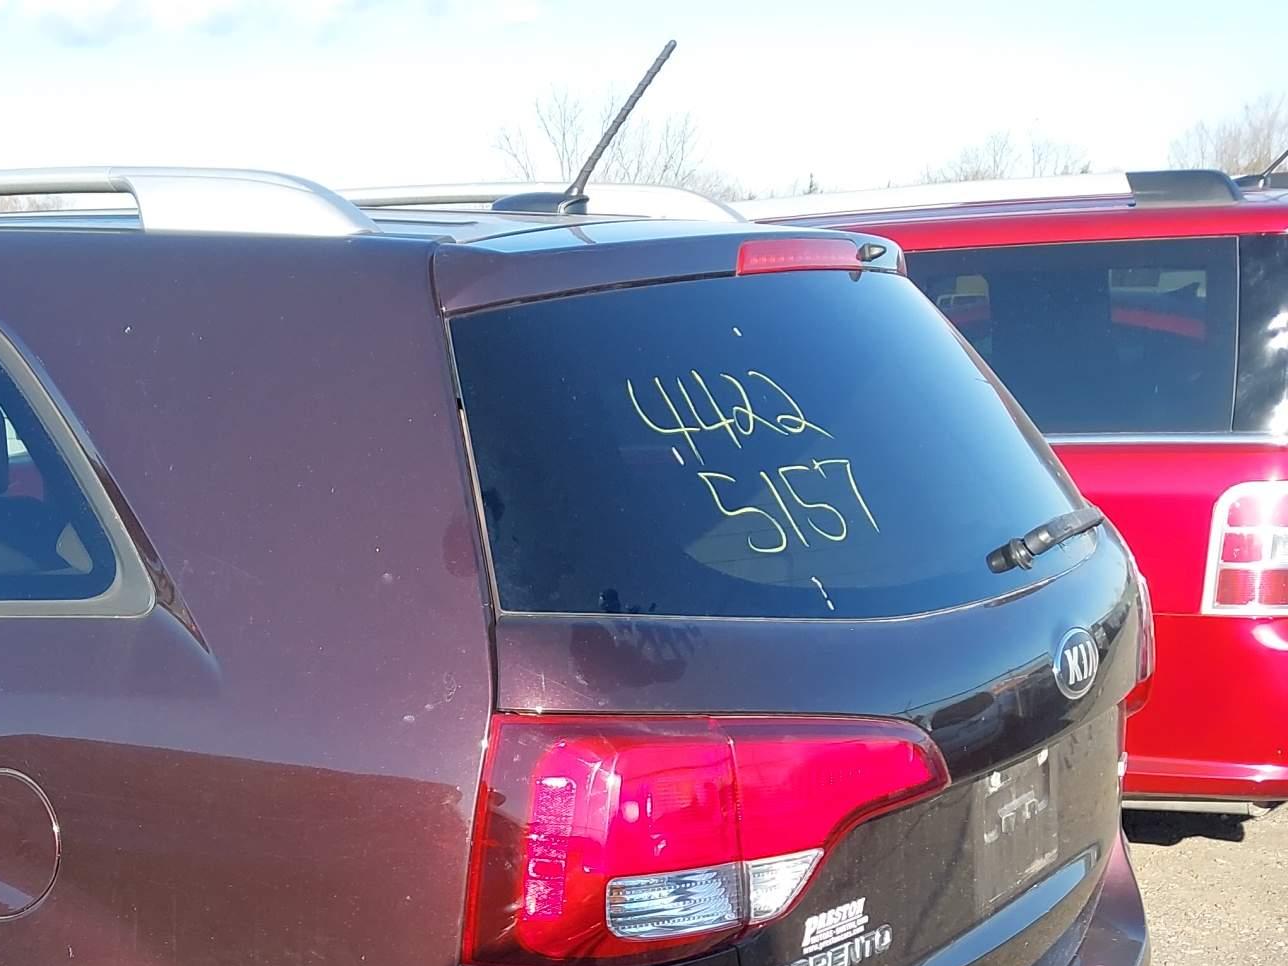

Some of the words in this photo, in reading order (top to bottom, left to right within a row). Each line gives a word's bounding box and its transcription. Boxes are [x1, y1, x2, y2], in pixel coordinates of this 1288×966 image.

[626, 369, 835, 466] 4422
[697, 458, 880, 553] 5157
[1063, 640, 1096, 686] KIA
